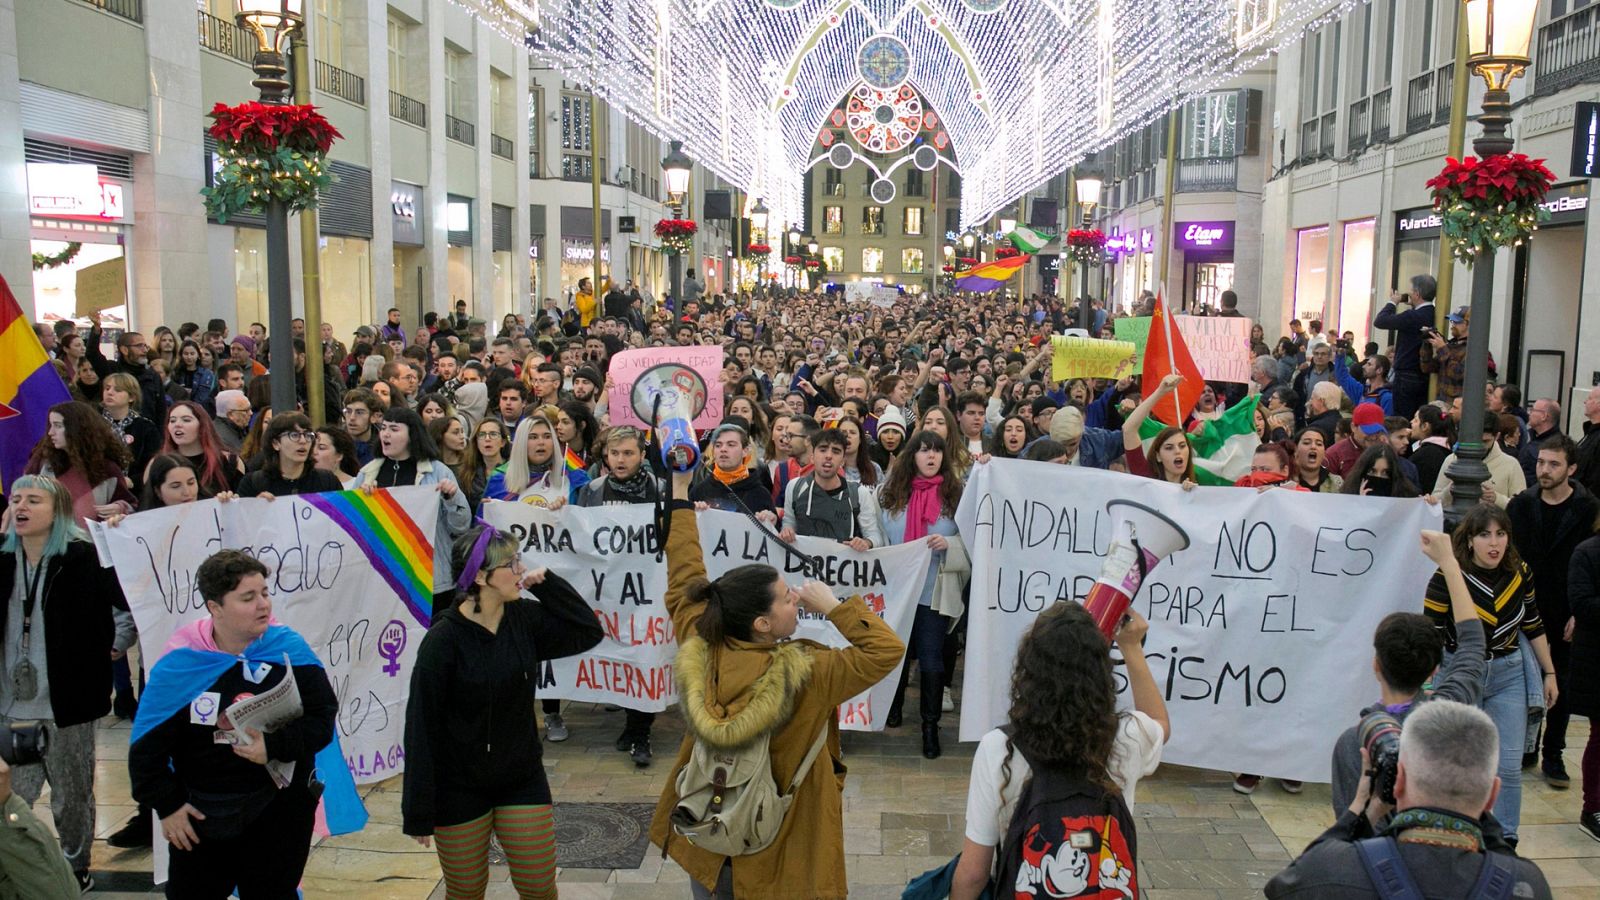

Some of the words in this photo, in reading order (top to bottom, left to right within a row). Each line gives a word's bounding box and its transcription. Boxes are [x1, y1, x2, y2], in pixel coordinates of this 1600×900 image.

[1184, 224, 1224, 240] Etam
[566, 247, 609, 260] SWAROKI
[688, 356, 716, 368] EDAD
[510, 522, 577, 554] PARA
[593, 523, 658, 555] COMB
[712, 528, 730, 557] A
[741, 530, 770, 563] LA
[1214, 519, 1277, 574] NO
[1311, 526, 1377, 577] ES
[591, 568, 605, 602] Y
[619, 571, 653, 606] AL
[1147, 582, 1227, 630] PARA
[1260, 594, 1316, 633] EL
[327, 618, 370, 667] en
